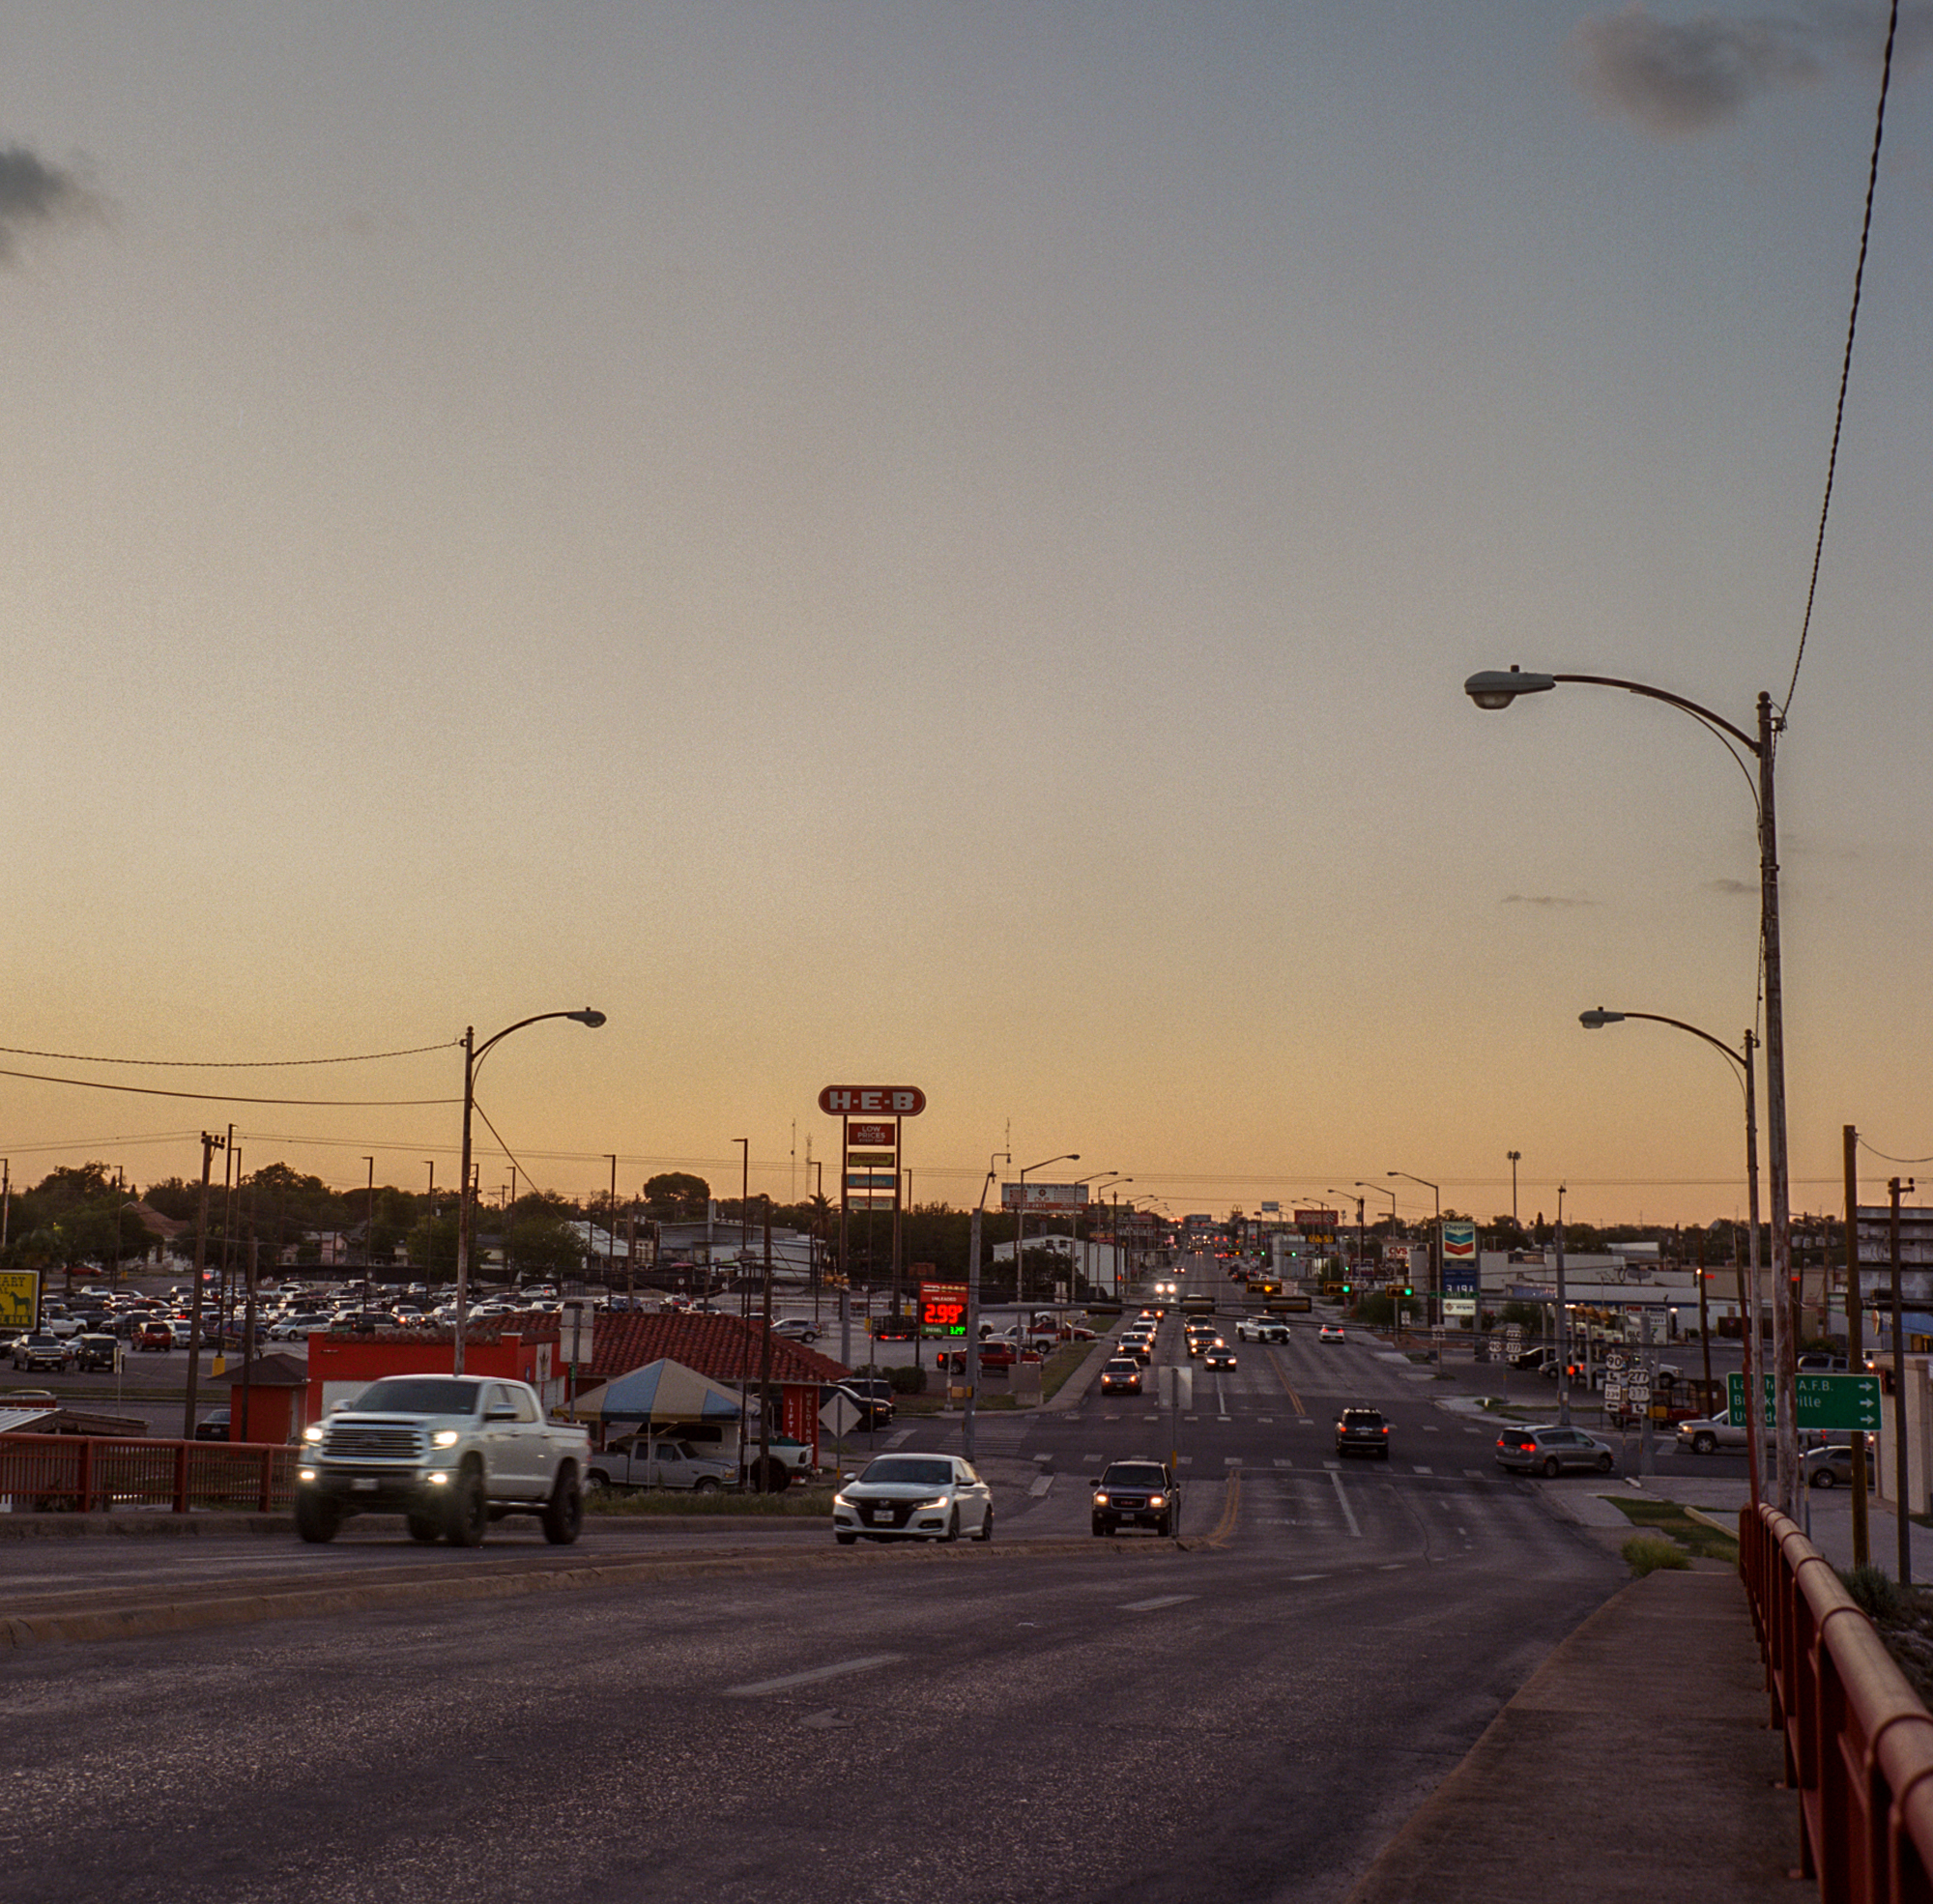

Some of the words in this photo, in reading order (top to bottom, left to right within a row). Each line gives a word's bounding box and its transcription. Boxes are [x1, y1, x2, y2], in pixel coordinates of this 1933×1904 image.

[1389, 1247, 1408, 1255] CVS
[1508, 1343, 1521, 1352] 377
[1607, 1356, 1622, 1367] 90
[1629, 1371, 1648, 1381] 277
[1799, 1380, 1834, 1392] A.F.B.
[1630, 1389, 1648, 1398] 377
